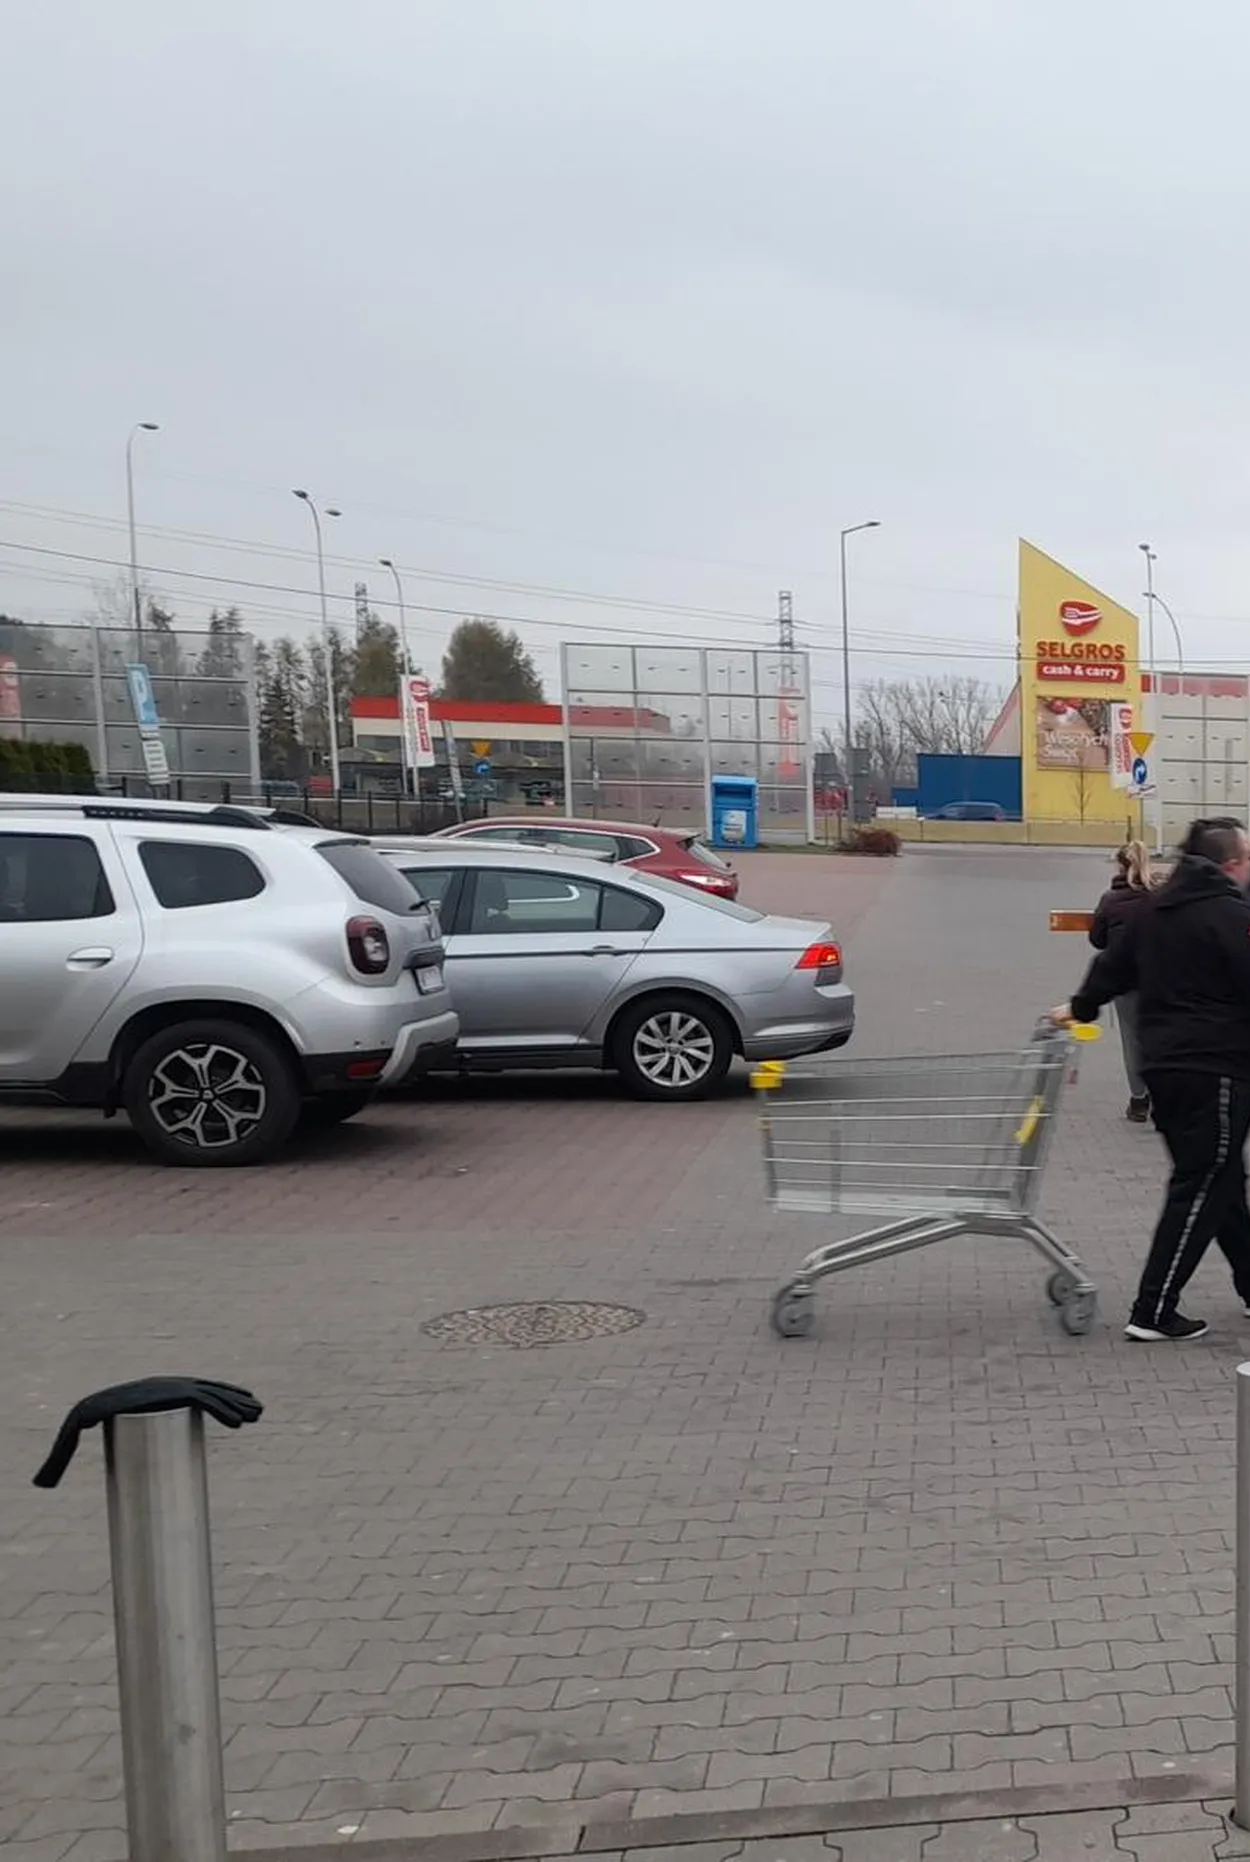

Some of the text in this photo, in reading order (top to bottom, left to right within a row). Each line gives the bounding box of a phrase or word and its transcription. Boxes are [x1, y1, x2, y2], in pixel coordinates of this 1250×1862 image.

[1036, 641, 1125, 661] SELGROS
[1042, 664, 1120, 680] cash & carry
